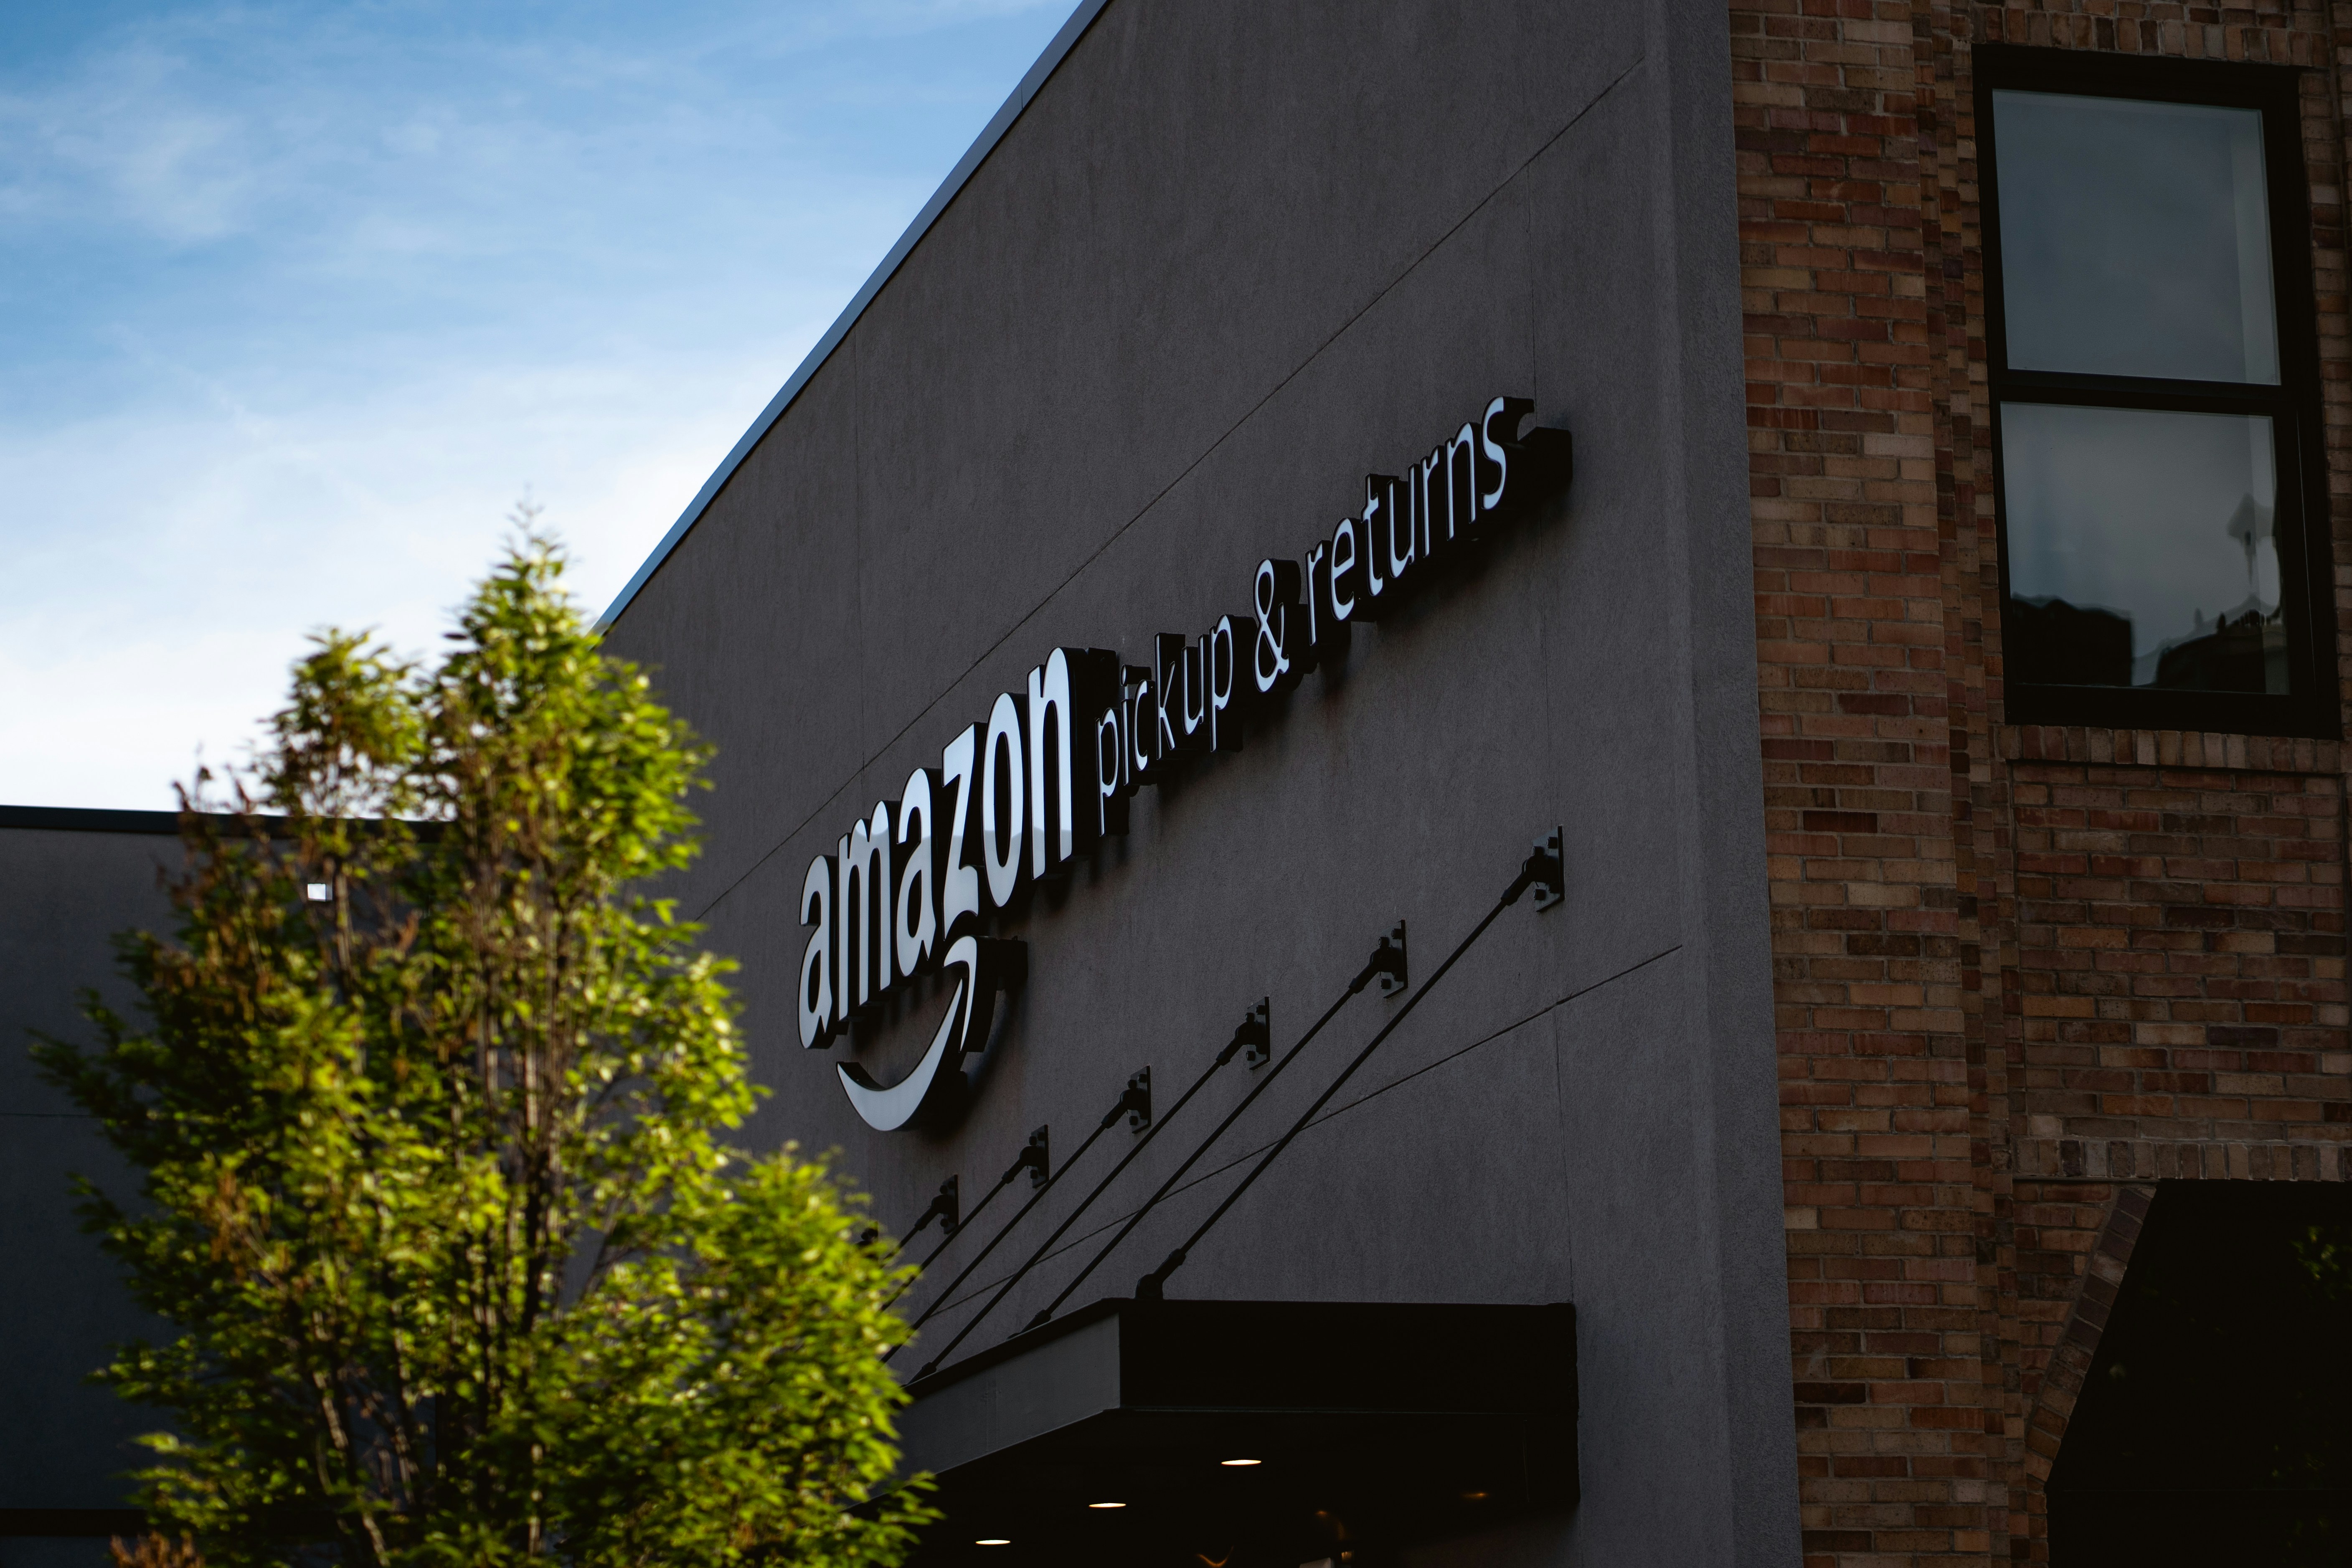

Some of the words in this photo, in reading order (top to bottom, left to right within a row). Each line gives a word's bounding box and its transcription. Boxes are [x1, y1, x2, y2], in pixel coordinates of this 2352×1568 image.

[798, 647, 1072, 1049] amazon
[1095, 614, 1233, 837] pickup
[1253, 559, 1289, 692] &
[1306, 396, 1507, 645] returns
